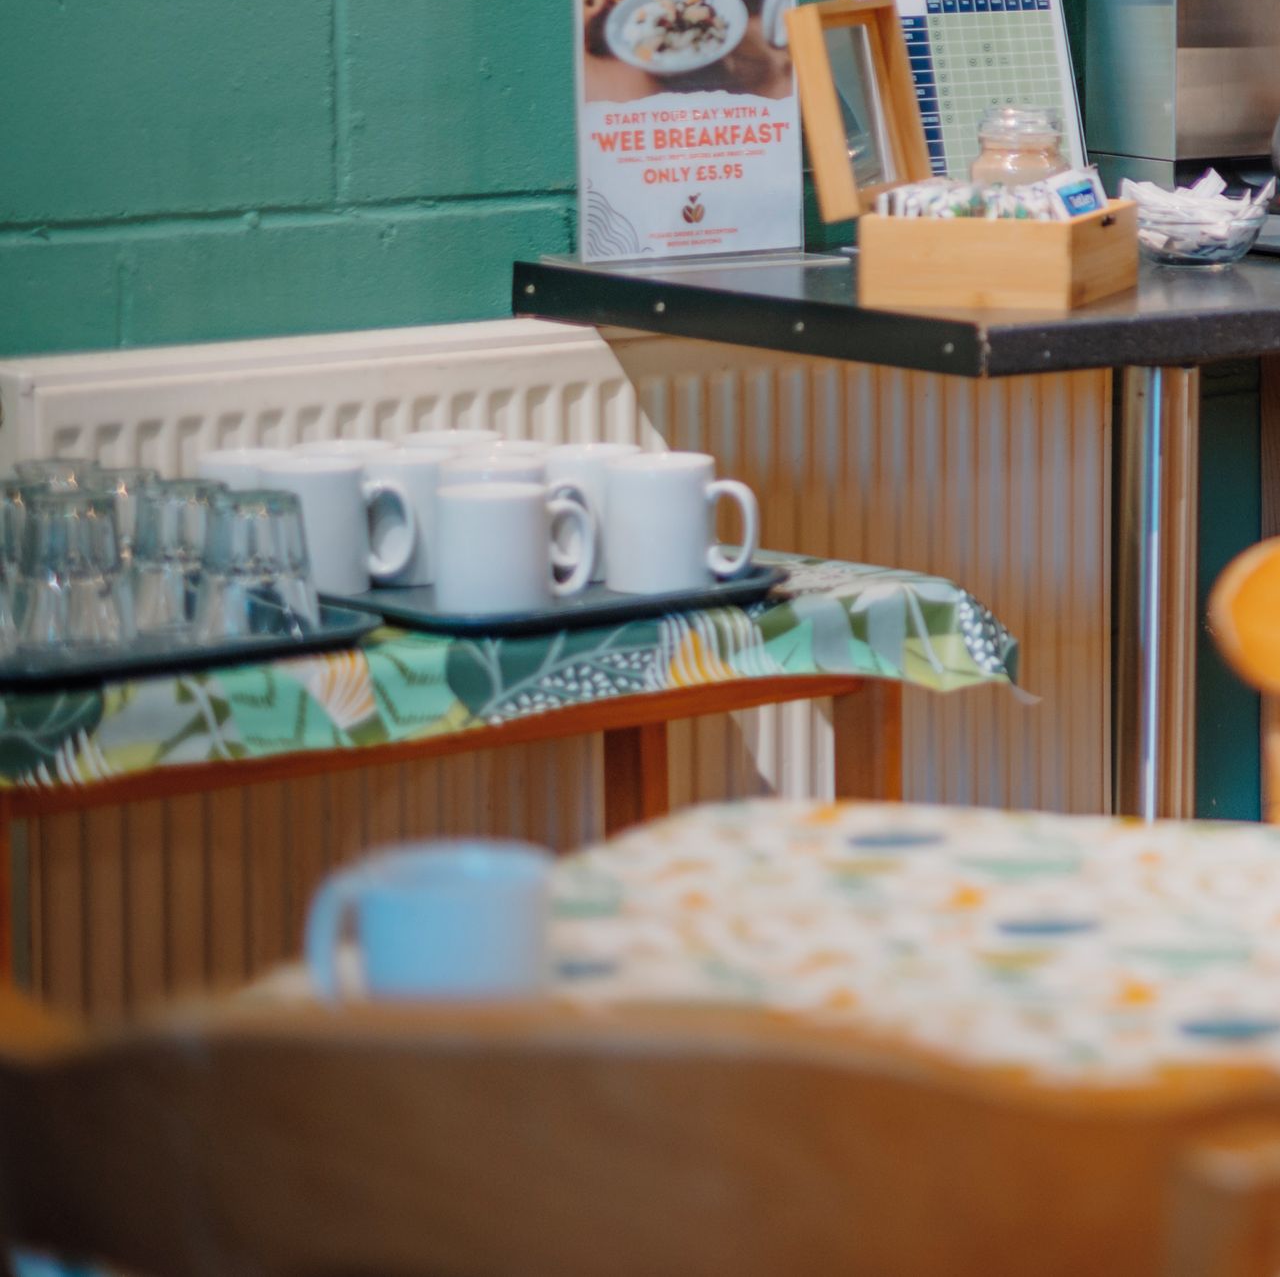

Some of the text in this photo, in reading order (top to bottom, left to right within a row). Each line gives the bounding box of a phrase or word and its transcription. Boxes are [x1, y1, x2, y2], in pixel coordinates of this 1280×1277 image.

[604, 106, 769, 126] START YOUR DAY WITH A
[643, 163, 743, 184] ONLY £5.95
